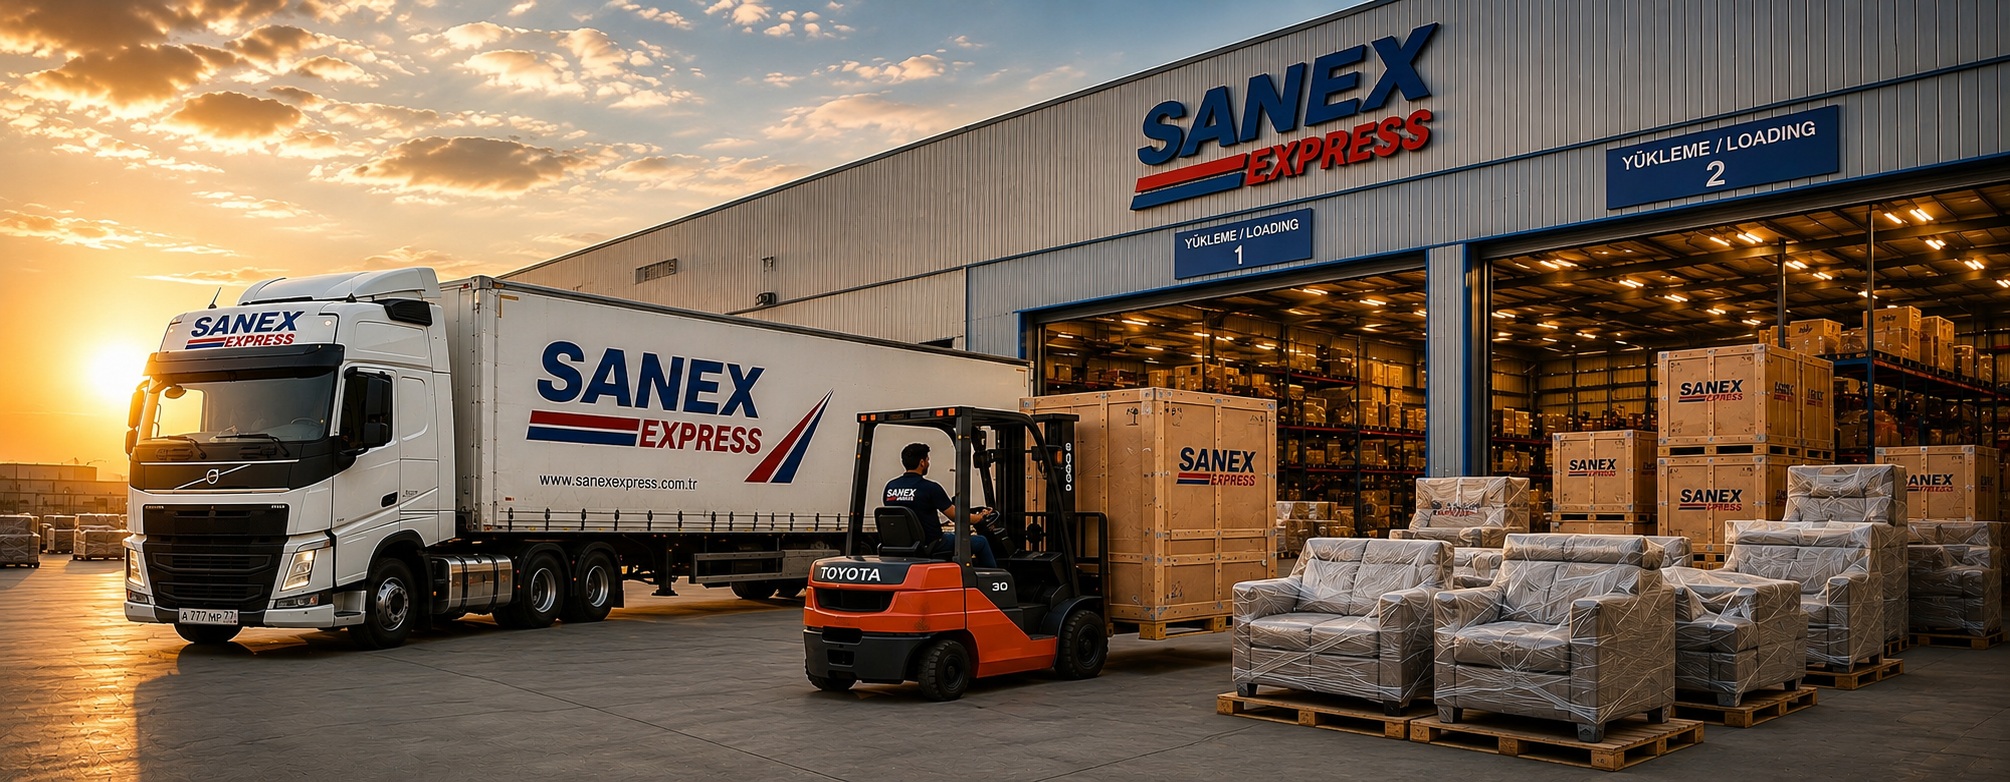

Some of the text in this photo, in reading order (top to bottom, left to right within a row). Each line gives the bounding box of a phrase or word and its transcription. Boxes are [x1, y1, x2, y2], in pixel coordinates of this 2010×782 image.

[1137, 22, 1439, 166] SANEX
[1727, 121, 1816, 151] LOADING
[1246, 108, 1433, 186] EXPRESS
[1705, 160, 1726, 188] 2
[1246, 218, 1299, 239] LOADING
[1234, 245, 1243, 265] 1
[191, 311, 305, 337] SANEX
[224, 333, 295, 347] EXPRESS
[537, 340, 766, 418] SANEX
[1680, 379, 1744, 396] SANEX
[638, 418, 763, 454] EXPRESS
[1178, 447, 1256, 473] SANEX
[1569, 459, 1617, 471] SANEX
[539, 474, 698, 491] www.sanexexpress.com.tr
[1210, 473, 1256, 487] EXPRESS
[1906, 473, 1954, 486] ANEX
[886, 488, 917, 497] SANEX
[1680, 488, 1742, 503] SANEX
[820, 566, 881, 582] TOYOTA
[991, 582, 1008, 591] 30
[182, 610, 234, 622] A 777 MP 77
